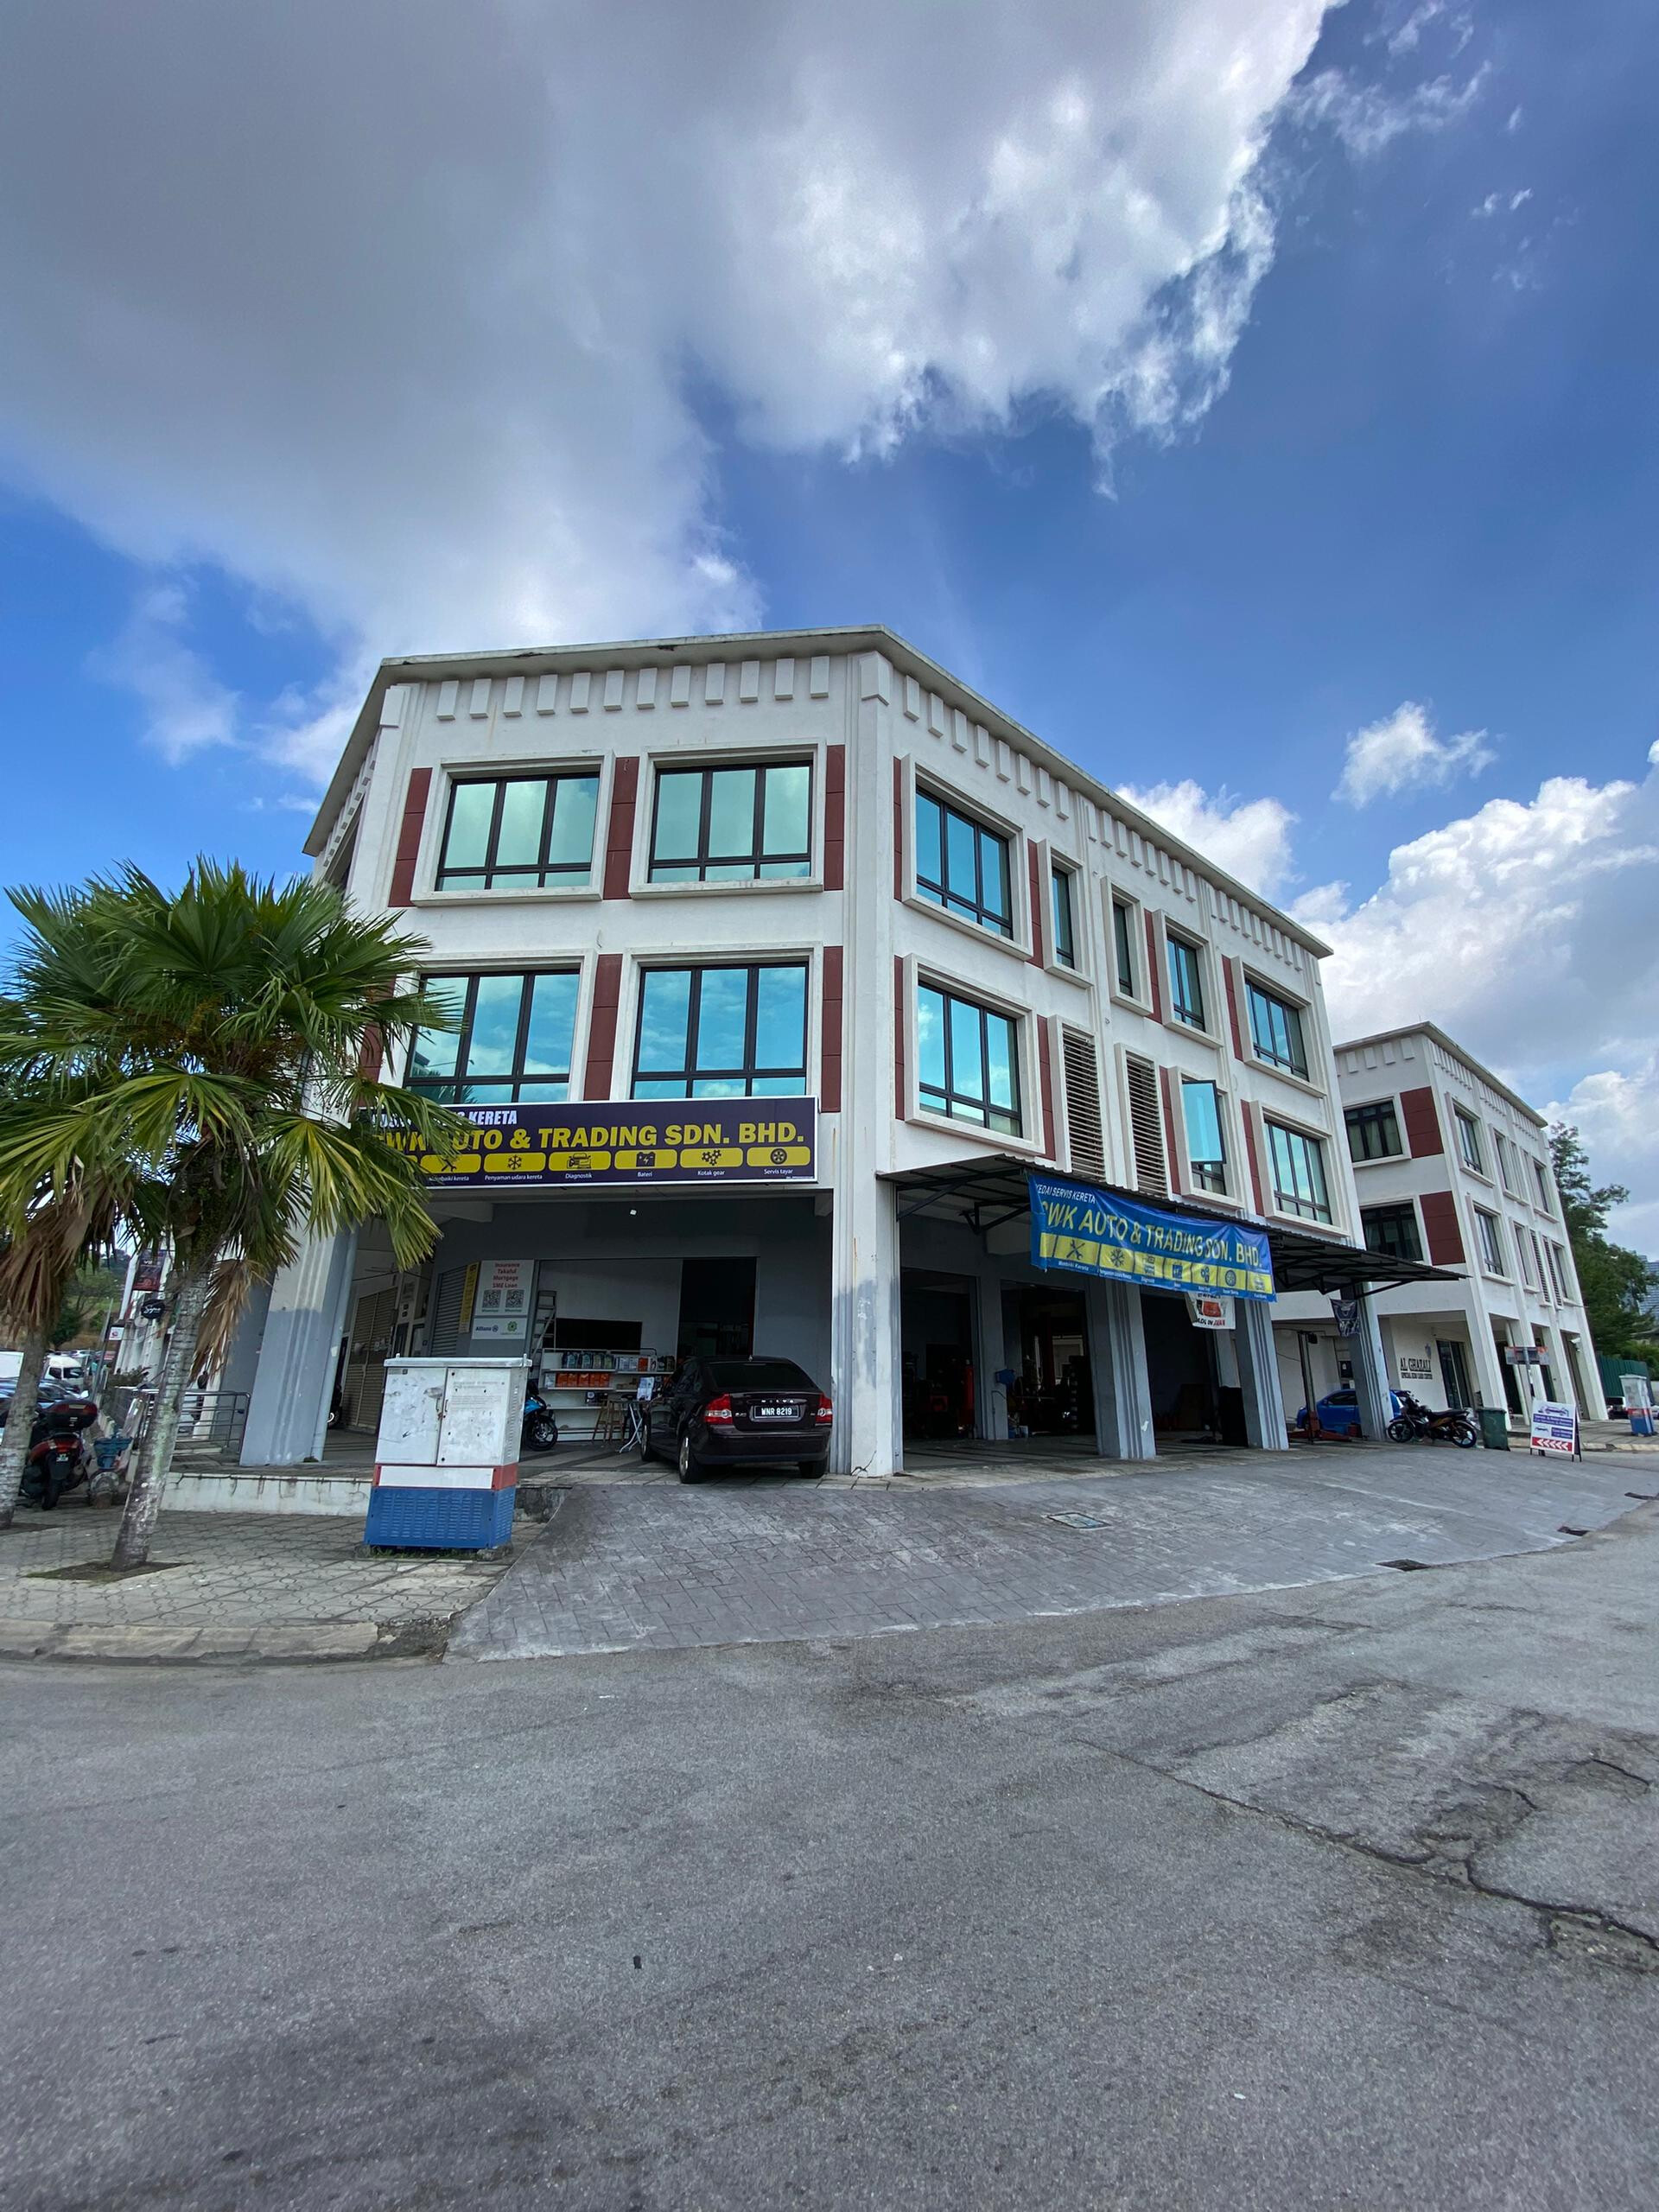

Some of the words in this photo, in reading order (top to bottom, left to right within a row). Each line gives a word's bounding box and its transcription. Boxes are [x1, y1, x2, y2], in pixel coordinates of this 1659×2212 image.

[467, 1110, 518, 1126] KERETA
[510, 1128, 531, 1149] &
[538, 1125, 657, 1148] TRADING
[664, 1123, 730, 1145] SDN.
[739, 1122, 804, 1143] BHD.
[1052, 1186, 1073, 1199] SERVIS
[1072, 1191, 1096, 1205] KERETA
[1078, 1209, 1128, 1241] AUTO
[1130, 1221, 1141, 1245] &
[1146, 1224, 1204, 1256] TRADING
[1236, 1243, 1262, 1268] BHD.
[761, 1407, 775, 1416] WNR
[776, 1407, 792, 1416] 8219
